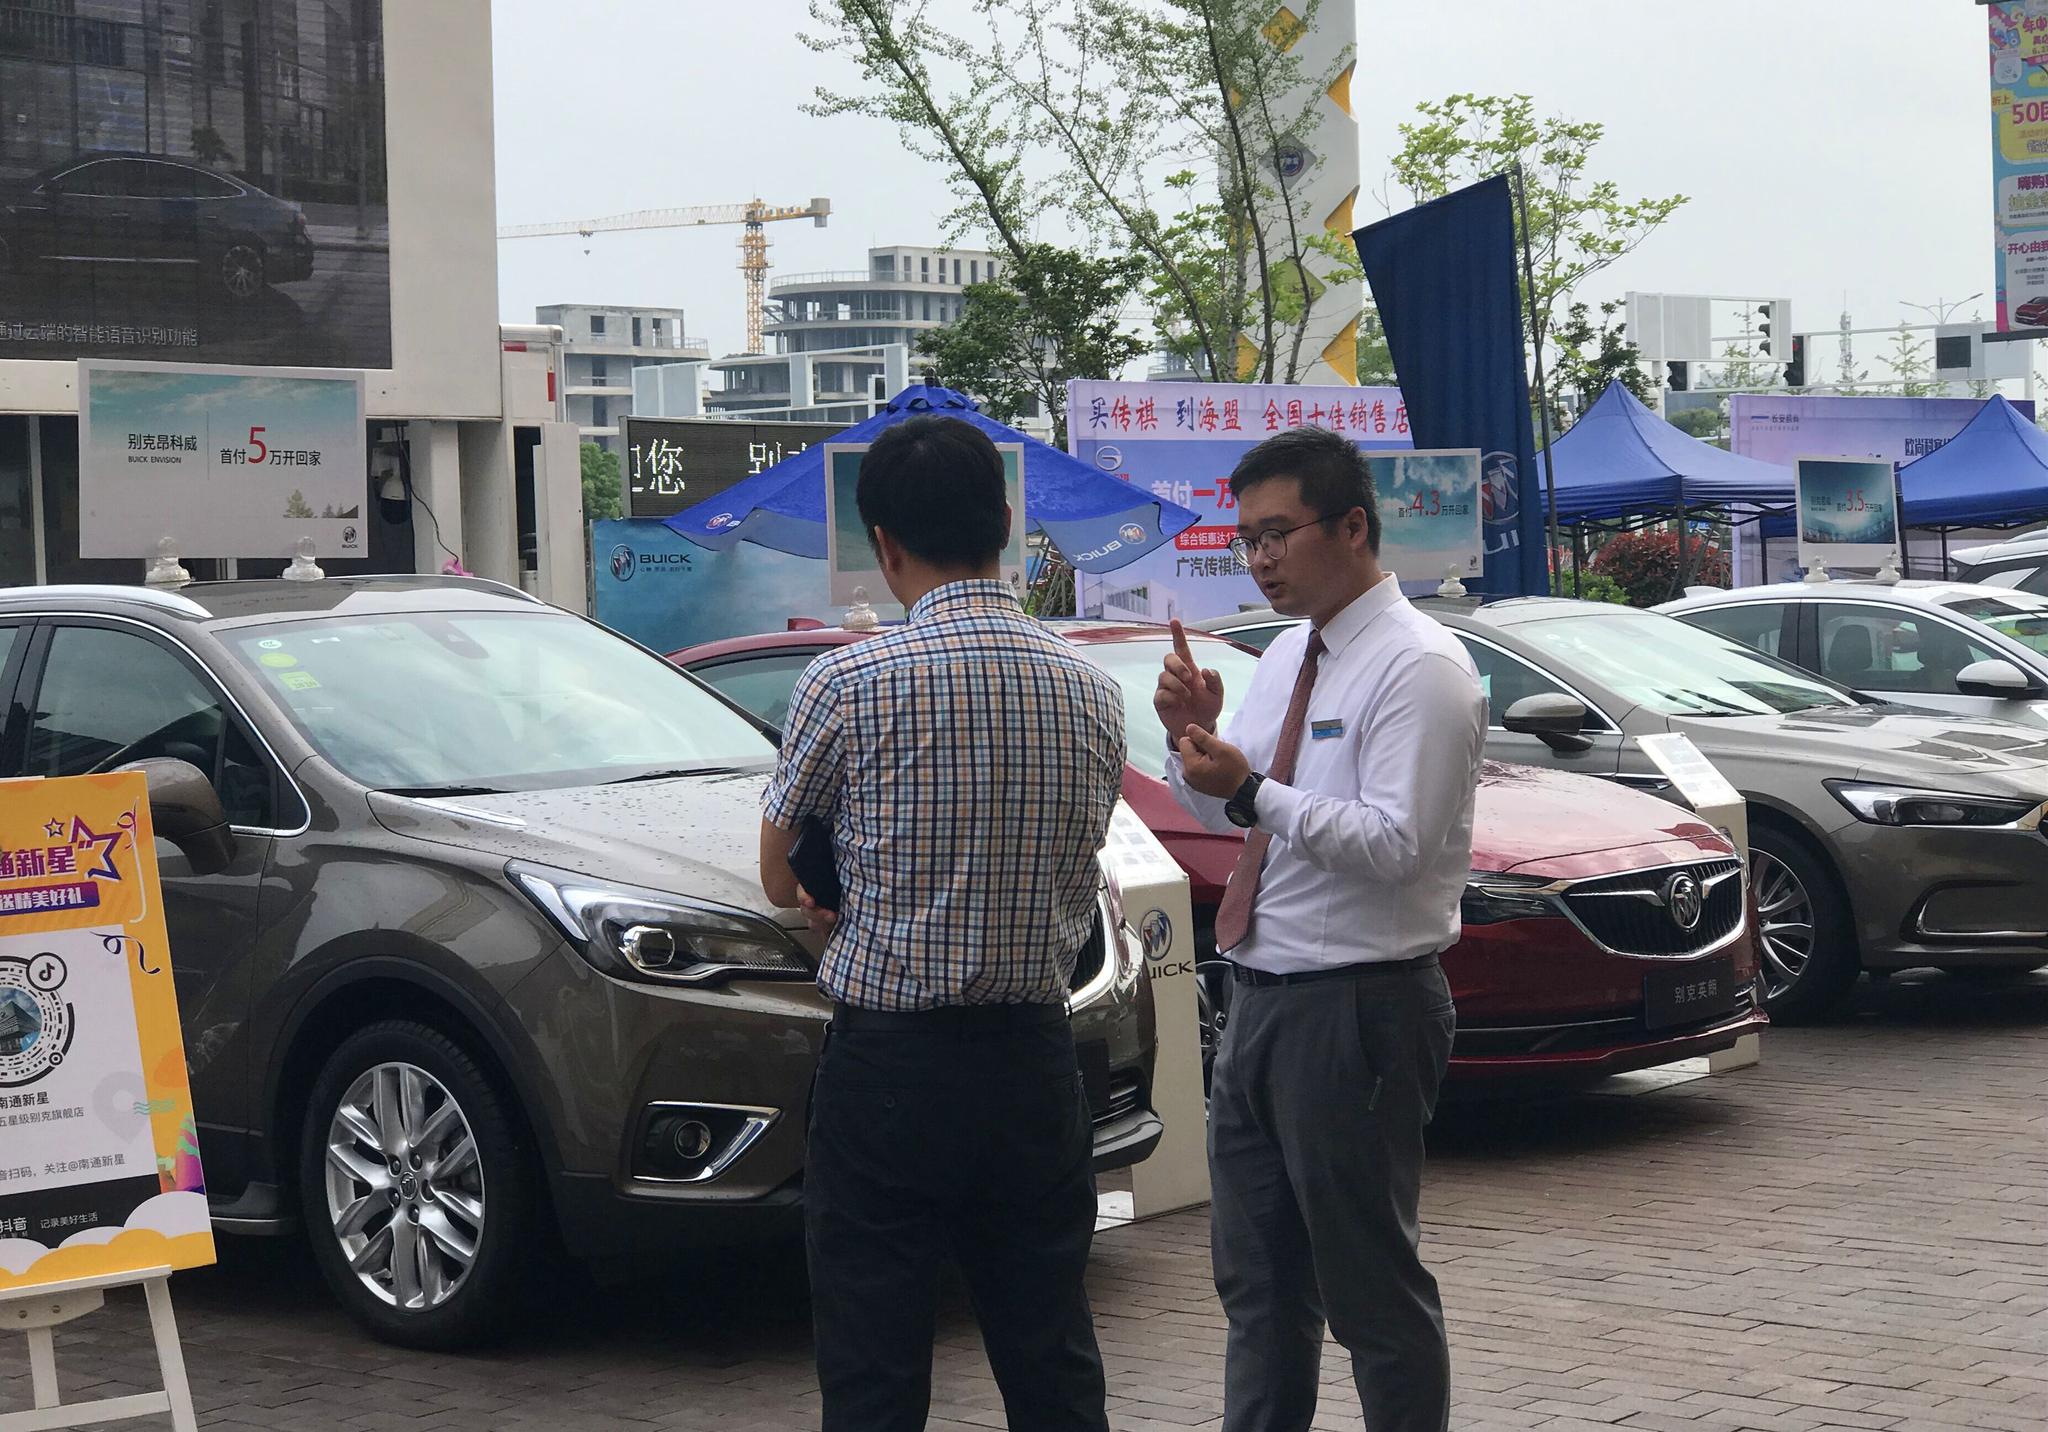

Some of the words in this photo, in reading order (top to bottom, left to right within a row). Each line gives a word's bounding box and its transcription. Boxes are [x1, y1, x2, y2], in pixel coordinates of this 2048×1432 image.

[1089, 395, 1158, 432] 买传祺
[1176, 396, 1241, 432] 到海盟
[128, 433, 198, 452] 别克昂科威
[220, 426, 321, 466] 首付5万开回家
[128, 456, 148, 464] BUICK
[151, 456, 181, 464] ENVISION
[640, 554, 692, 564] BUICK
[1176, 556, 1250, 577] 广汽传祺热
[1675, 980, 1717, 1003] 别克英朗
[40, 1211, 98, 1229] 记录美好生活
